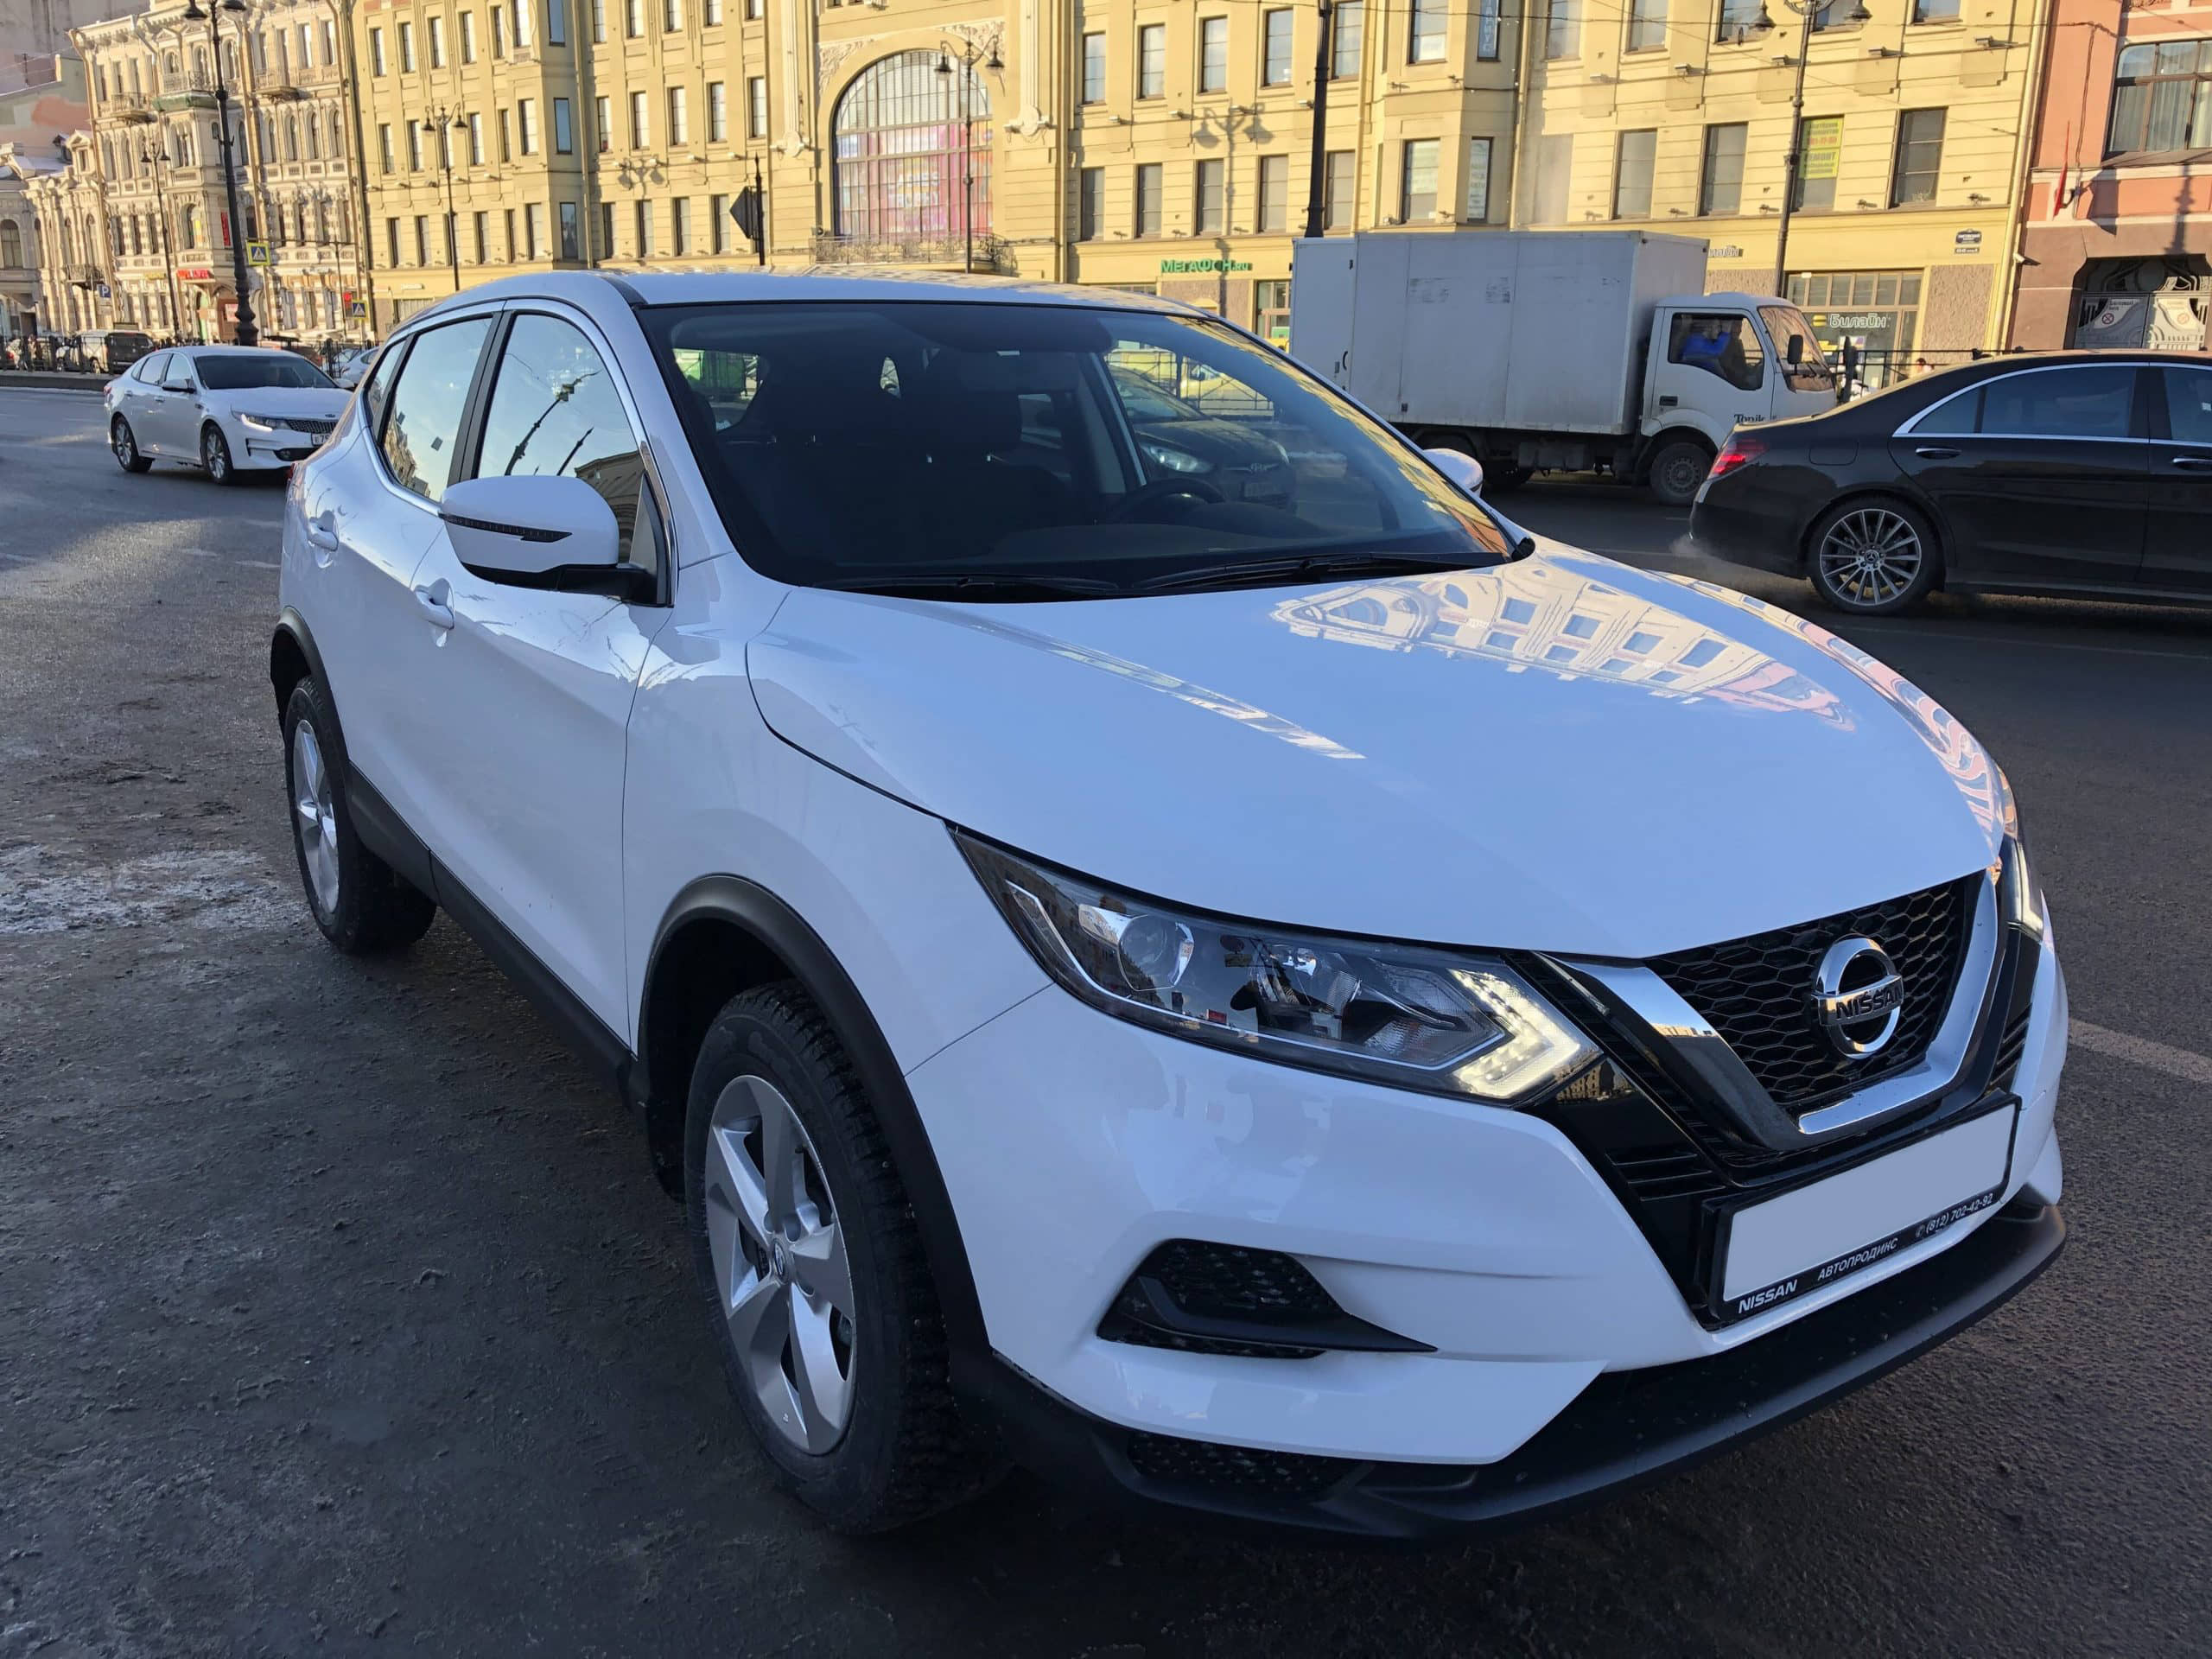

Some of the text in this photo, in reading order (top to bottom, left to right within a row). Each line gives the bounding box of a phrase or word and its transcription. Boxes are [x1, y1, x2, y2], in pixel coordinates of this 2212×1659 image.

[1835, 982, 1902, 1020] NISSAN
[1738, 1279, 1798, 1314] NISSAN
[1817, 1237, 1898, 1281] АВТОПРОДИКС
